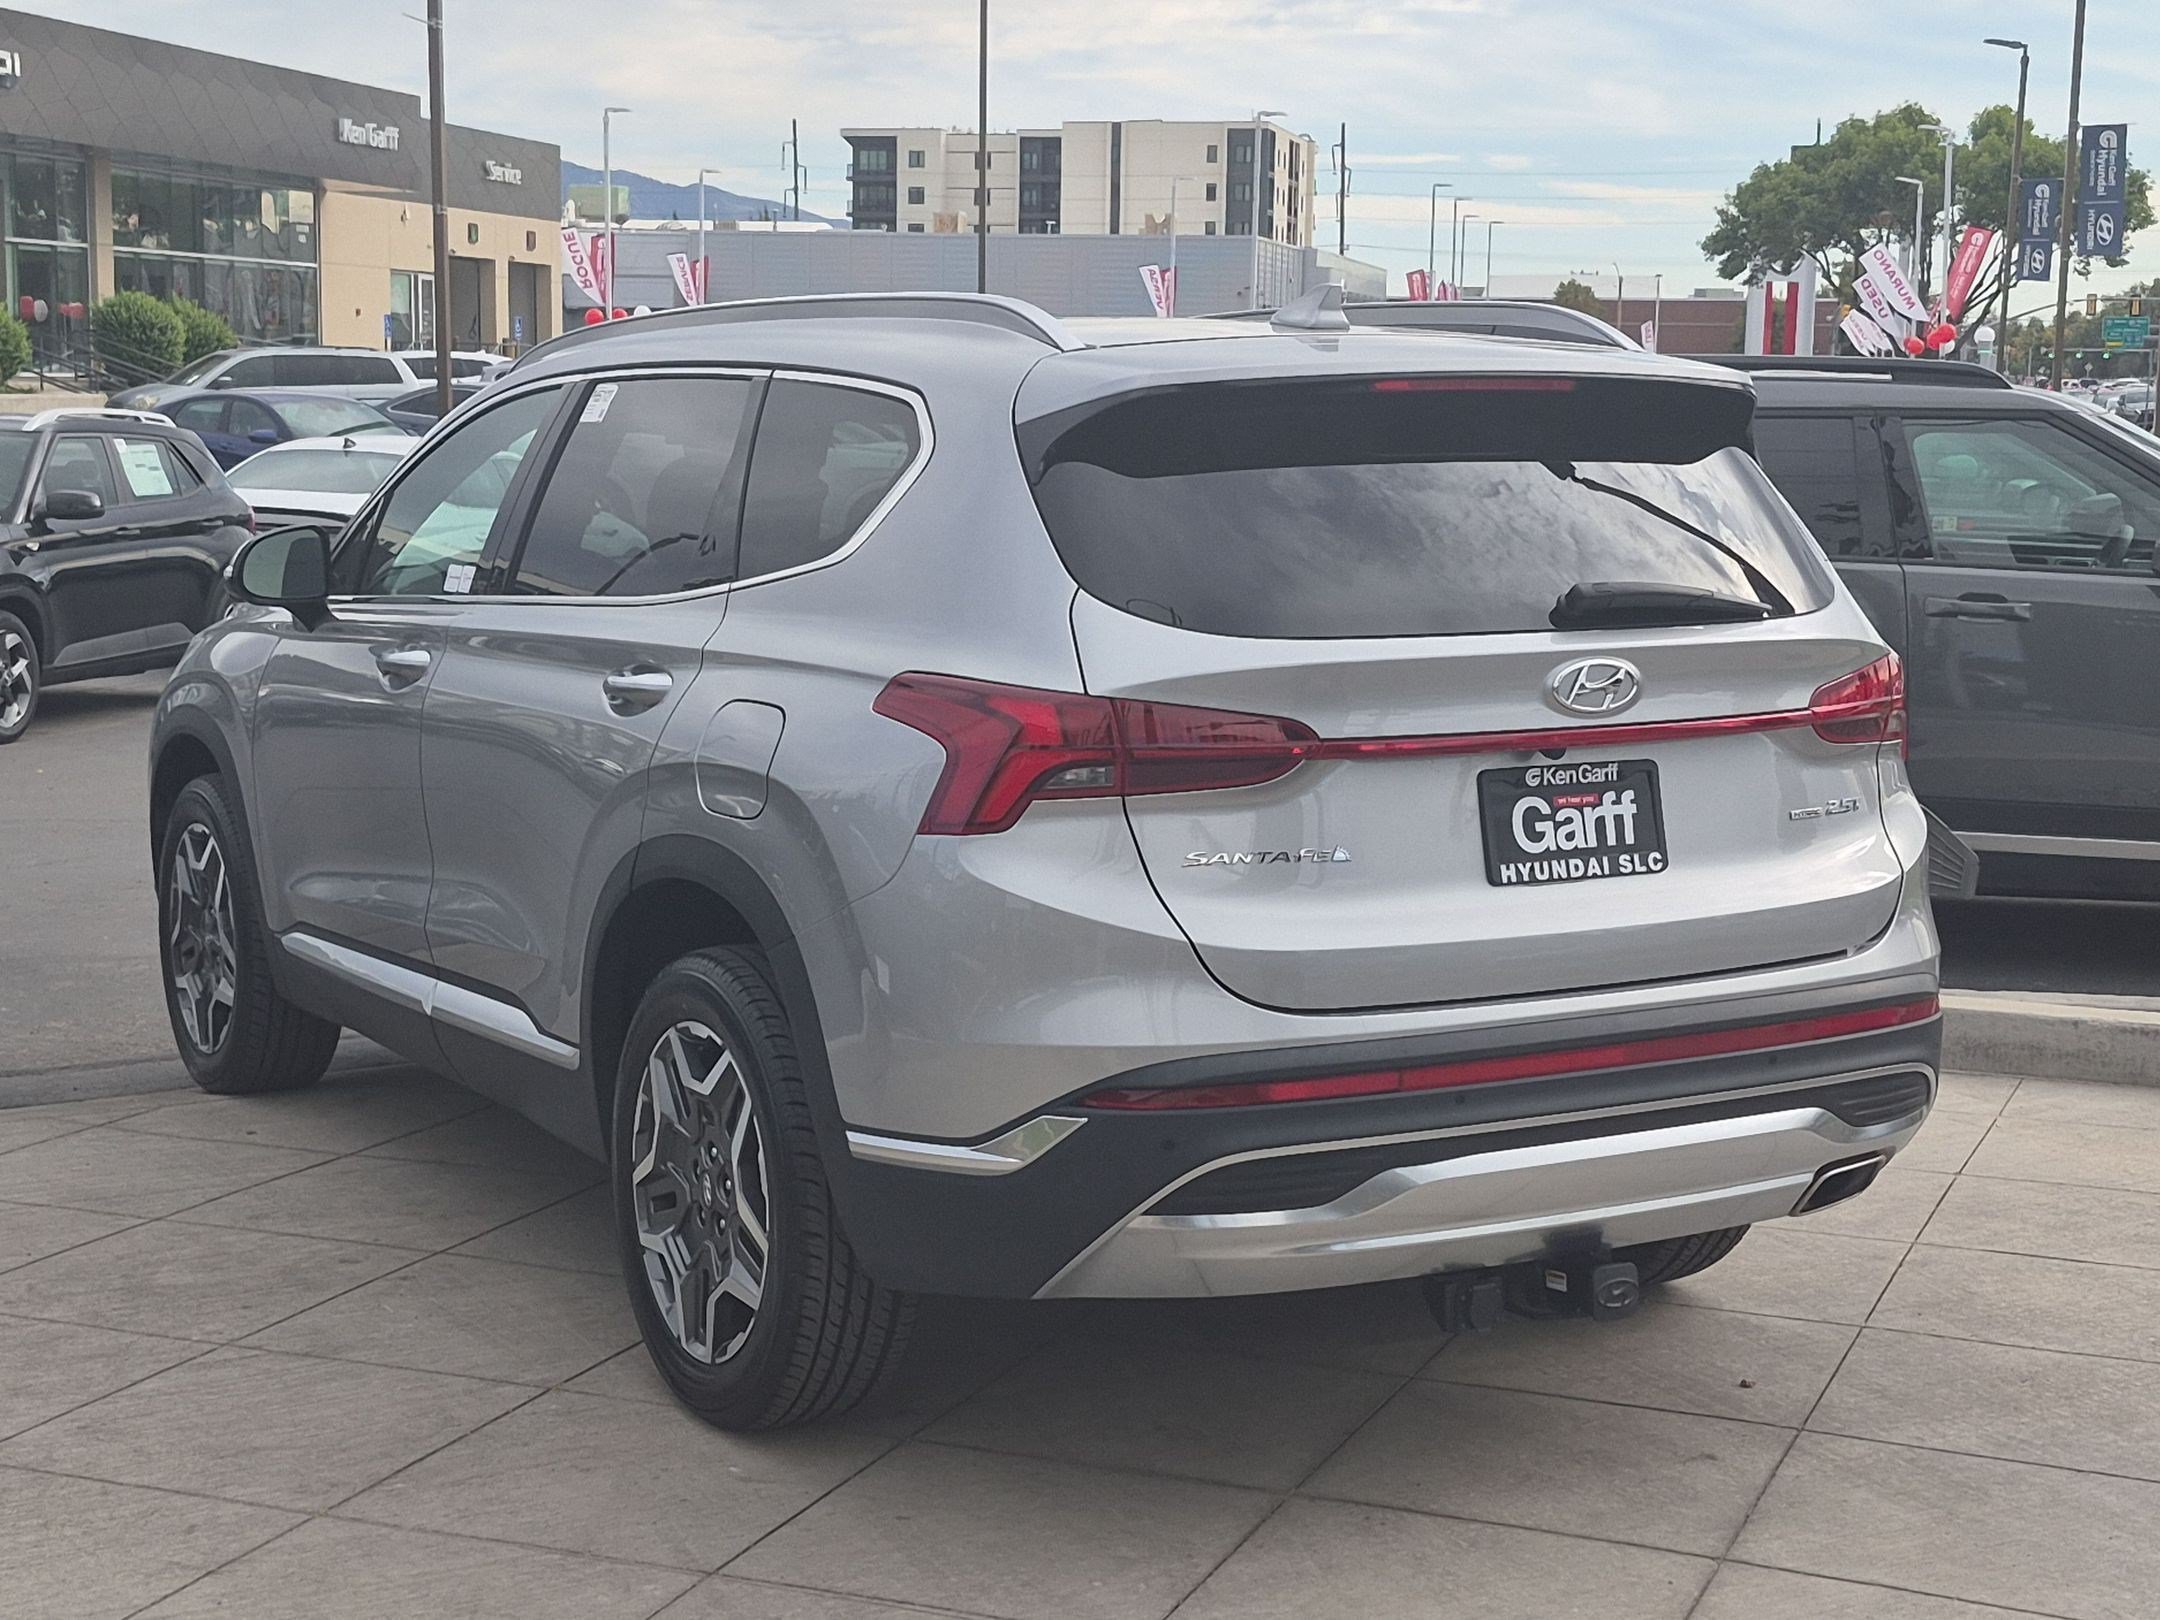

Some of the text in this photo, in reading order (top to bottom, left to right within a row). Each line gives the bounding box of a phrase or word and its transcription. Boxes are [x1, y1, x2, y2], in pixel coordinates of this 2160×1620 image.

[338, 118, 400, 150] Ken Garff
[485, 160, 522, 185] Service
[1543, 767, 1577, 786] Ken
[1578, 763, 1619, 784] Garff
[1512, 789, 1638, 854] Garff
[1182, 847, 1332, 868] SANTA FE
[1500, 851, 1664, 884] HYUNDAI SLC
